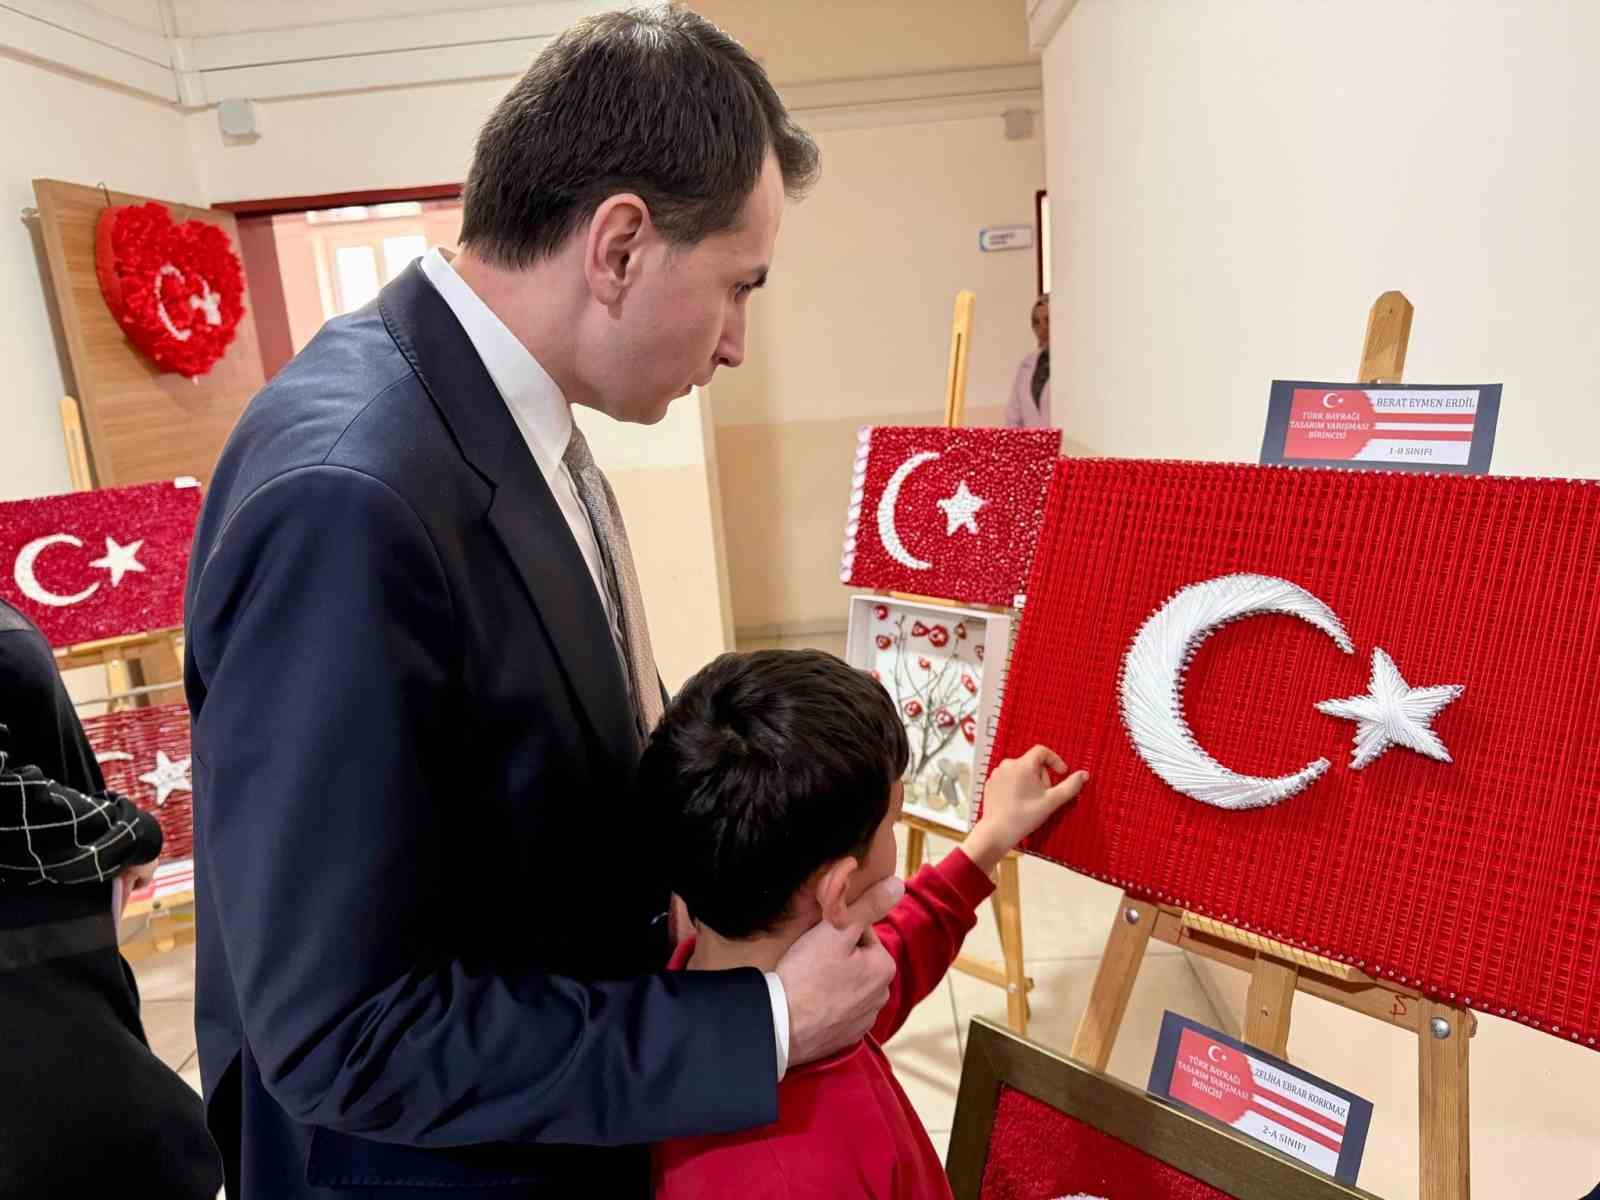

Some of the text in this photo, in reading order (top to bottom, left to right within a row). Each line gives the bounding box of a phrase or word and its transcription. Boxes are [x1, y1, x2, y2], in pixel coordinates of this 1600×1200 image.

[1376, 397, 1406, 409] BERAT
[1409, 397, 1443, 409] EYMEN
[1255, 1068, 1346, 1118] ZELİHA EBRAR KORKMAZ
